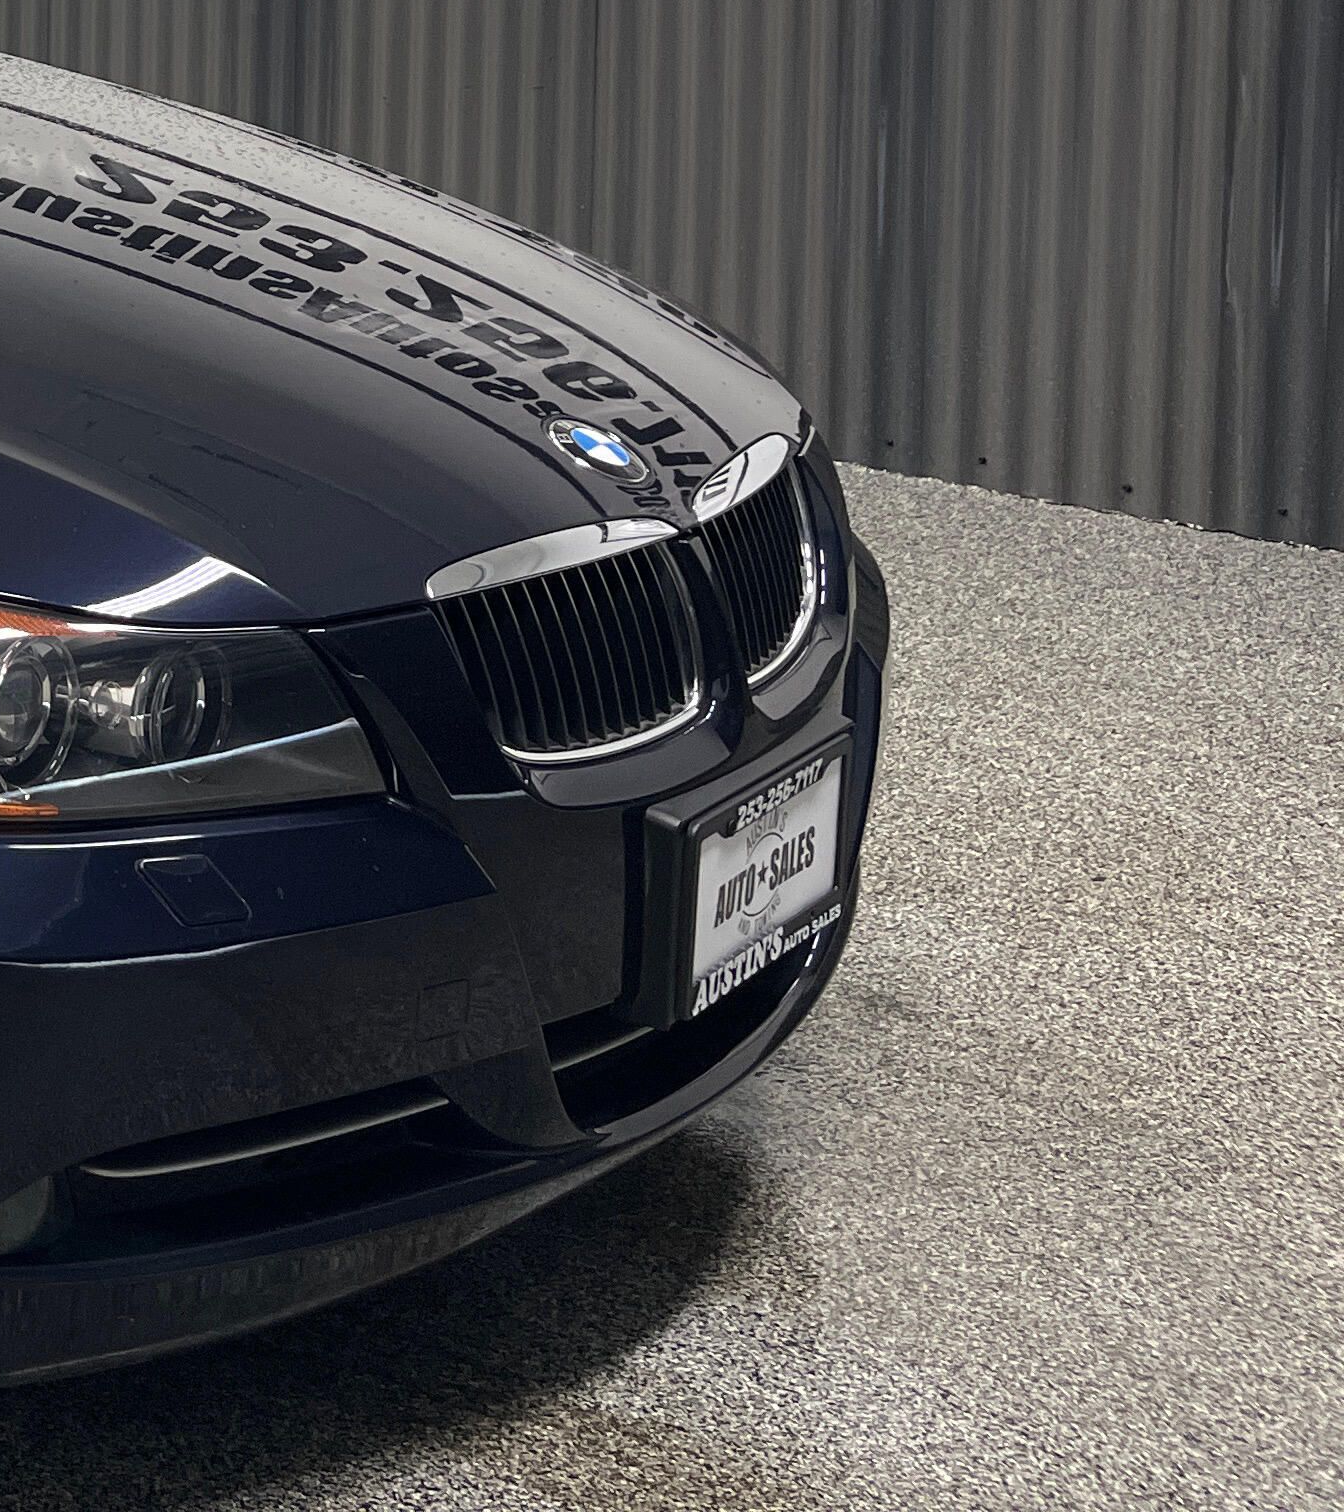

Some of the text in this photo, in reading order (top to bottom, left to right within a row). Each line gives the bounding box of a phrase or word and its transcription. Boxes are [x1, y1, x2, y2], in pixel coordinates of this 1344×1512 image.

[736, 757, 824, 832] 253-256-7117
[713, 862, 756, 929] AUTO
[768, 825, 816, 891] SALES
[691, 925, 785, 1017] AUSTIN'S
[783, 924, 811, 954] AUTO
[811, 903, 842, 934] SALES
